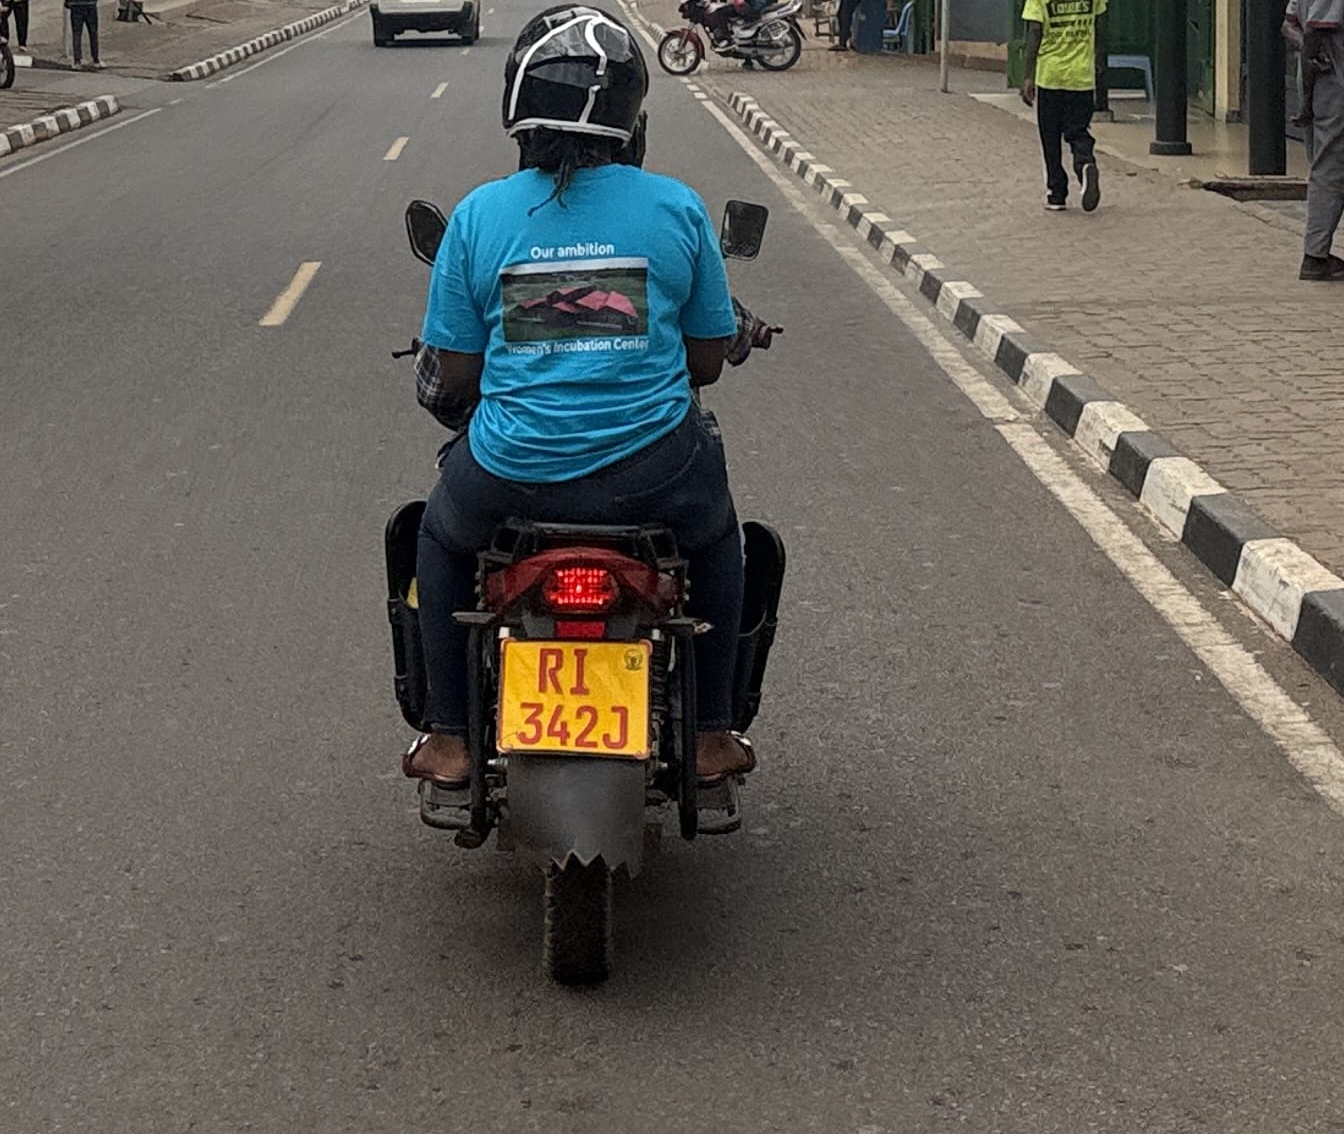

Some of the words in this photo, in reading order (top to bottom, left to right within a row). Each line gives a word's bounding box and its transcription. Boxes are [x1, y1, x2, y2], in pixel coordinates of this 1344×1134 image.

[530, 246, 554, 259] Our
[558, 241, 614, 258] ambition
[506, 342, 551, 355] Women's
[554, 338, 611, 353] Incubation
[613, 337, 650, 351] Center
[538, 648, 590, 695] RI
[518, 702, 629, 750] 342J
